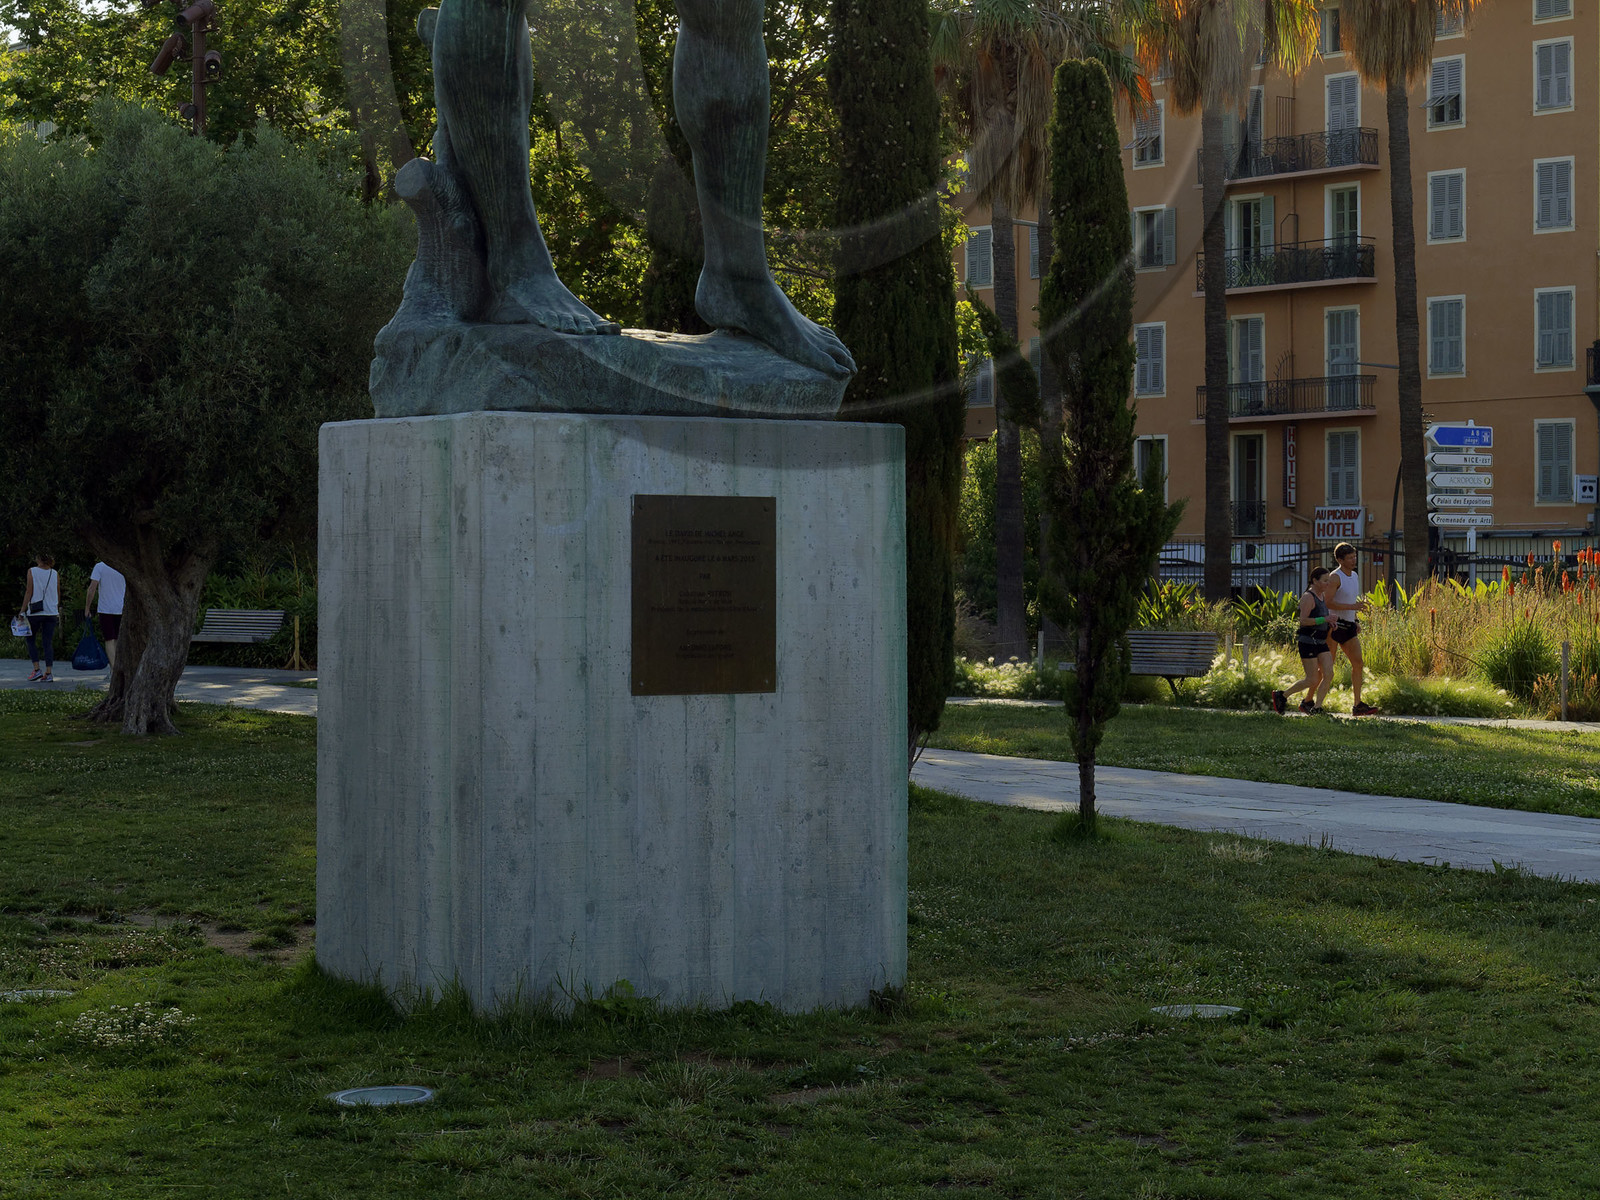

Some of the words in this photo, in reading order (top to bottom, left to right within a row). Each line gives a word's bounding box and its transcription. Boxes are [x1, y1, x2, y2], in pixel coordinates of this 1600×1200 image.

[1288, 427, 1296, 505] HOTEL
[1448, 477, 1483, 485] ACROPOLIS
[1436, 497, 1452, 505] Palais
[1453, 497, 1462, 505] des
[1463, 497, 1491, 506] Expositions
[1315, 509, 1327, 521] AU
[1327, 509, 1362, 521] PICARDY
[1436, 516, 1466, 524] Promenade
[1467, 516, 1478, 524] des
[1479, 517, 1491, 525] Arts
[1316, 522, 1361, 537] HOTEL
